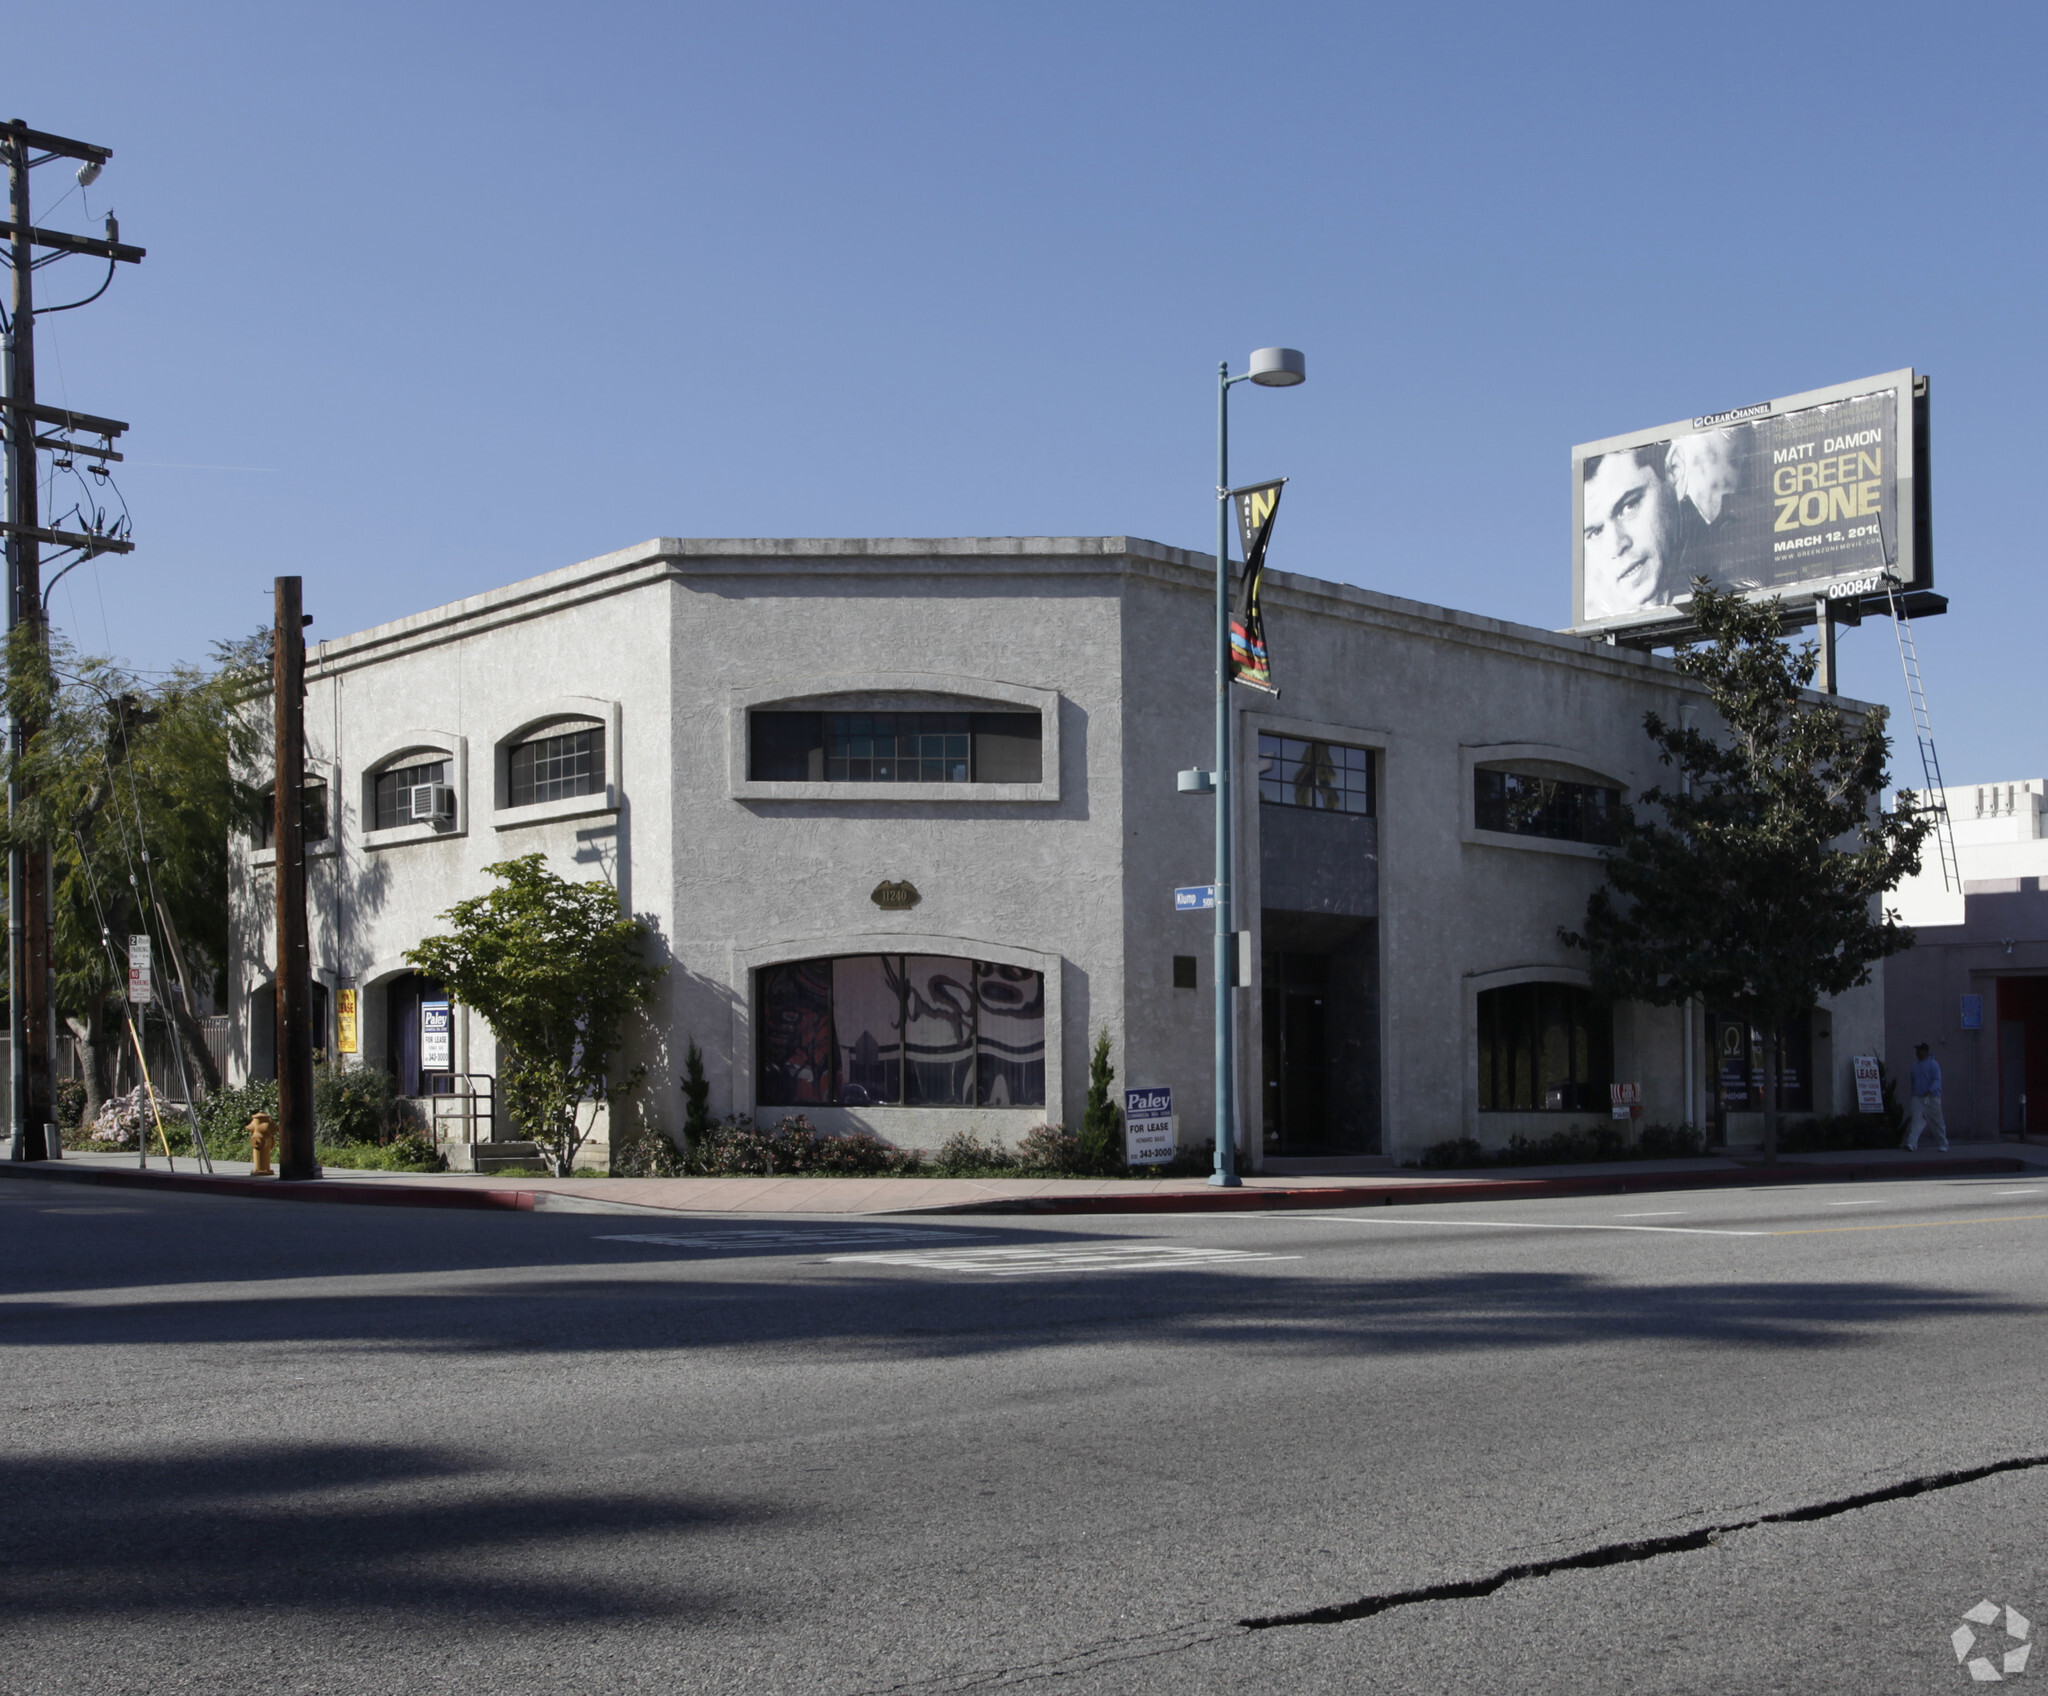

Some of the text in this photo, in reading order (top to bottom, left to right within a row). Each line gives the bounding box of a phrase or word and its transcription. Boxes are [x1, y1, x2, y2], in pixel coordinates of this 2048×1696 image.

[1774, 428, 1882, 464] MATT DAMON
[1774, 447, 1881, 496] GREEN
[1774, 478, 1881, 533] ZONE
[1774, 535, 1822, 552] MARCH
[1825, 531, 1845, 542] 12,
[1829, 576, 1879, 599] 000847
[882, 890, 907, 902] 11240
[1177, 893, 1197, 906] Klump
[131, 936, 137, 945] 2
[425, 1012, 447, 1027] Paley
[1856, 1068, 1878, 1079] LEASE
[1128, 1092, 1170, 1111] Paley
[1130, 1122, 1169, 1133] FOR LEASE
[1139, 1148, 1172, 1159] 343-3000
